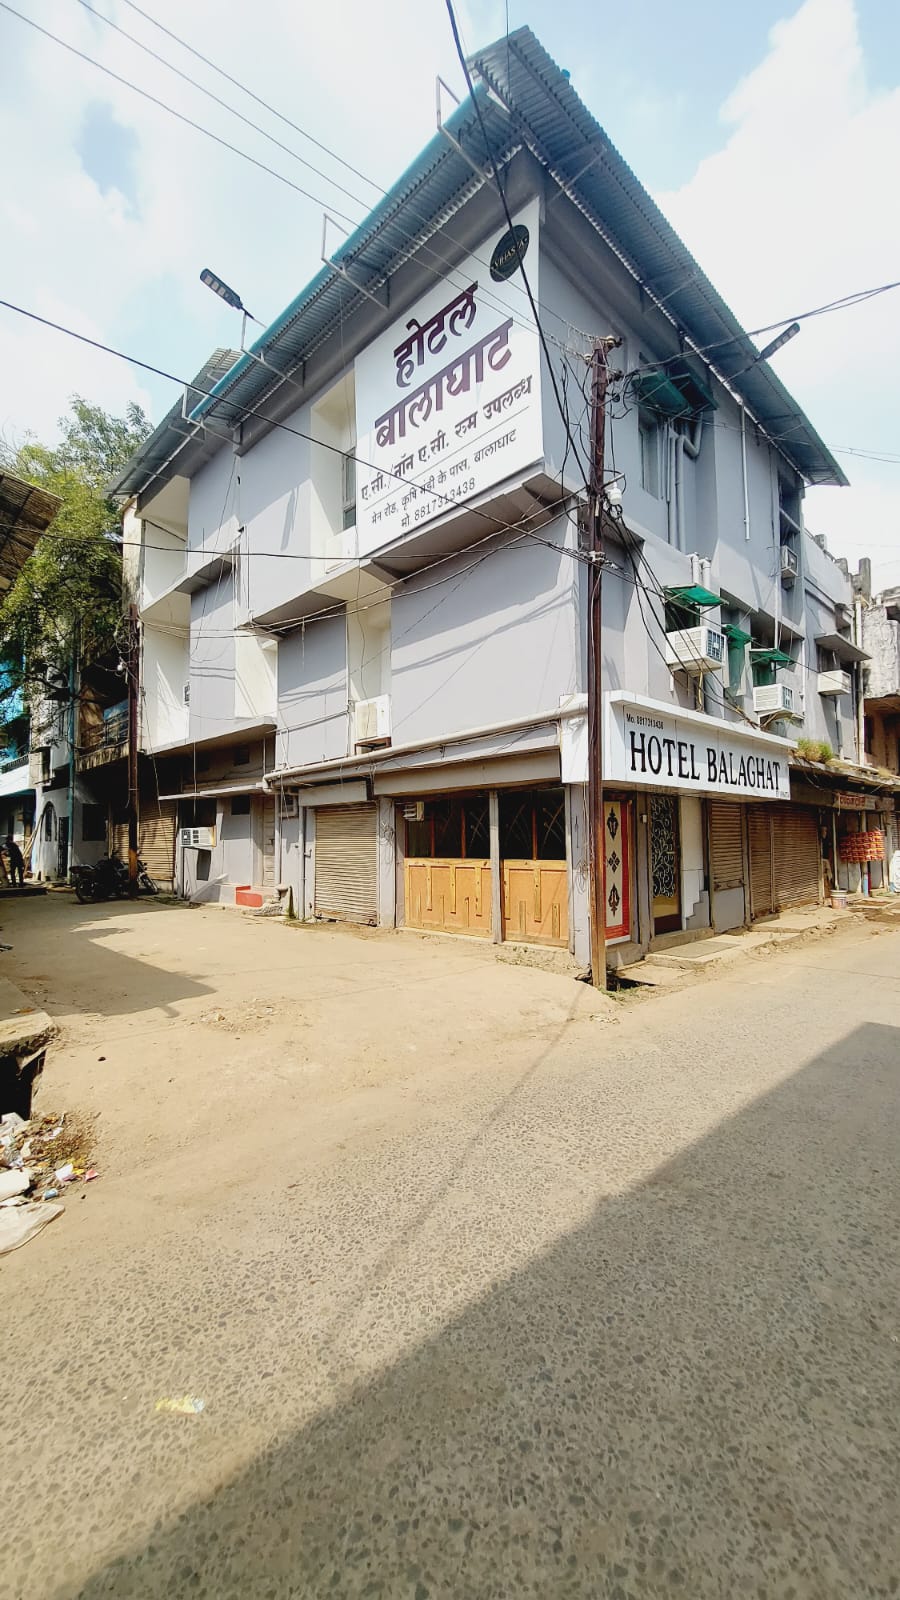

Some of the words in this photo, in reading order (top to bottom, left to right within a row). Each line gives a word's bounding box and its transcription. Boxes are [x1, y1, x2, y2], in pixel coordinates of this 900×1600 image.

[494, 239, 524, 267] VIHASA
[394, 281, 477, 388] होटल
[375, 318, 513, 447] बालाघाट
[418, 429, 449, 462] ए.सी.
[482, 375, 533, 419] उपलब्ध
[371, 509, 382, 524] मेन
[401, 486, 417, 511] कृषि
[437, 470, 447, 484] के
[473, 428, 517, 463] बालाघाट
[414, 477, 476, 520] 8817313438
[629, 731, 700, 780] HOTEL
[707, 747, 781, 791] BALAGHAT
